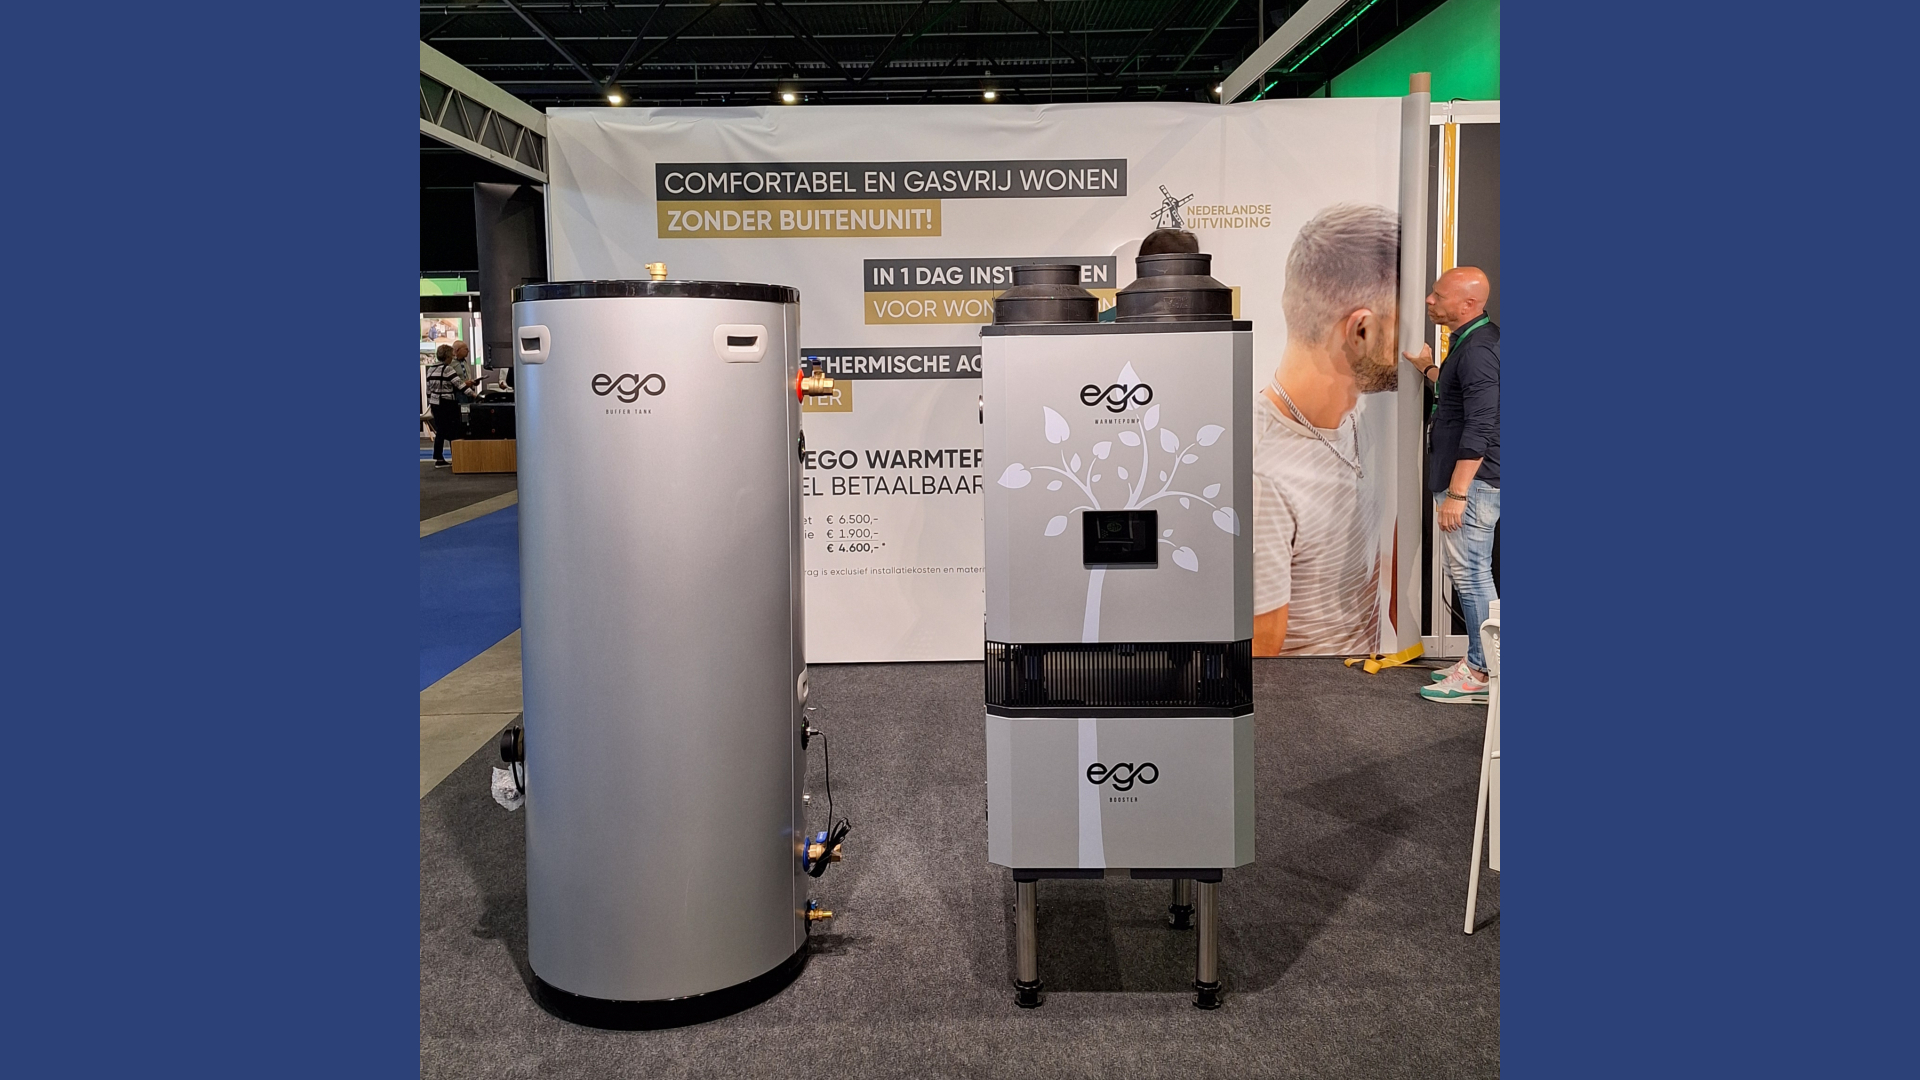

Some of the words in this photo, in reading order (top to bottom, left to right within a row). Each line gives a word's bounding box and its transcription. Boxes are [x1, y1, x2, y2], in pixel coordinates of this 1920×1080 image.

[664, 171, 857, 194] COMFORTABEL
[864, 171, 896, 193] EN
[903, 169, 1012, 193] GASVRIJ
[1019, 168, 1118, 191] WONEN
[667, 210, 773, 232] ZONDER
[779, 207, 933, 231] BUITENUNIT!
[1187, 204, 1272, 216] NEDERLANDSE
[1187, 216, 1272, 229] UITVINDING
[873, 267, 894, 285] IN
[900, 267, 909, 285] 1
[916, 266, 964, 285] DAG
[970, 264, 1107, 284] INSTEN
[873, 300, 937, 318] VOOR
[591, 373, 666, 404] ego
[1080, 383, 1153, 413] ego
[805, 450, 858, 470] EGO
[803, 476, 823, 496] EL
[826, 515, 834, 525] €
[839, 514, 879, 525] 6.500,-
[826, 529, 834, 539] €
[839, 528, 879, 539] 1.900,-
[827, 543, 834, 553] €
[821, 567, 828, 576] is
[830, 567, 868, 576] exclusief
[871, 566, 941, 575] installatiekosten
[1086, 762, 1159, 792] ego
